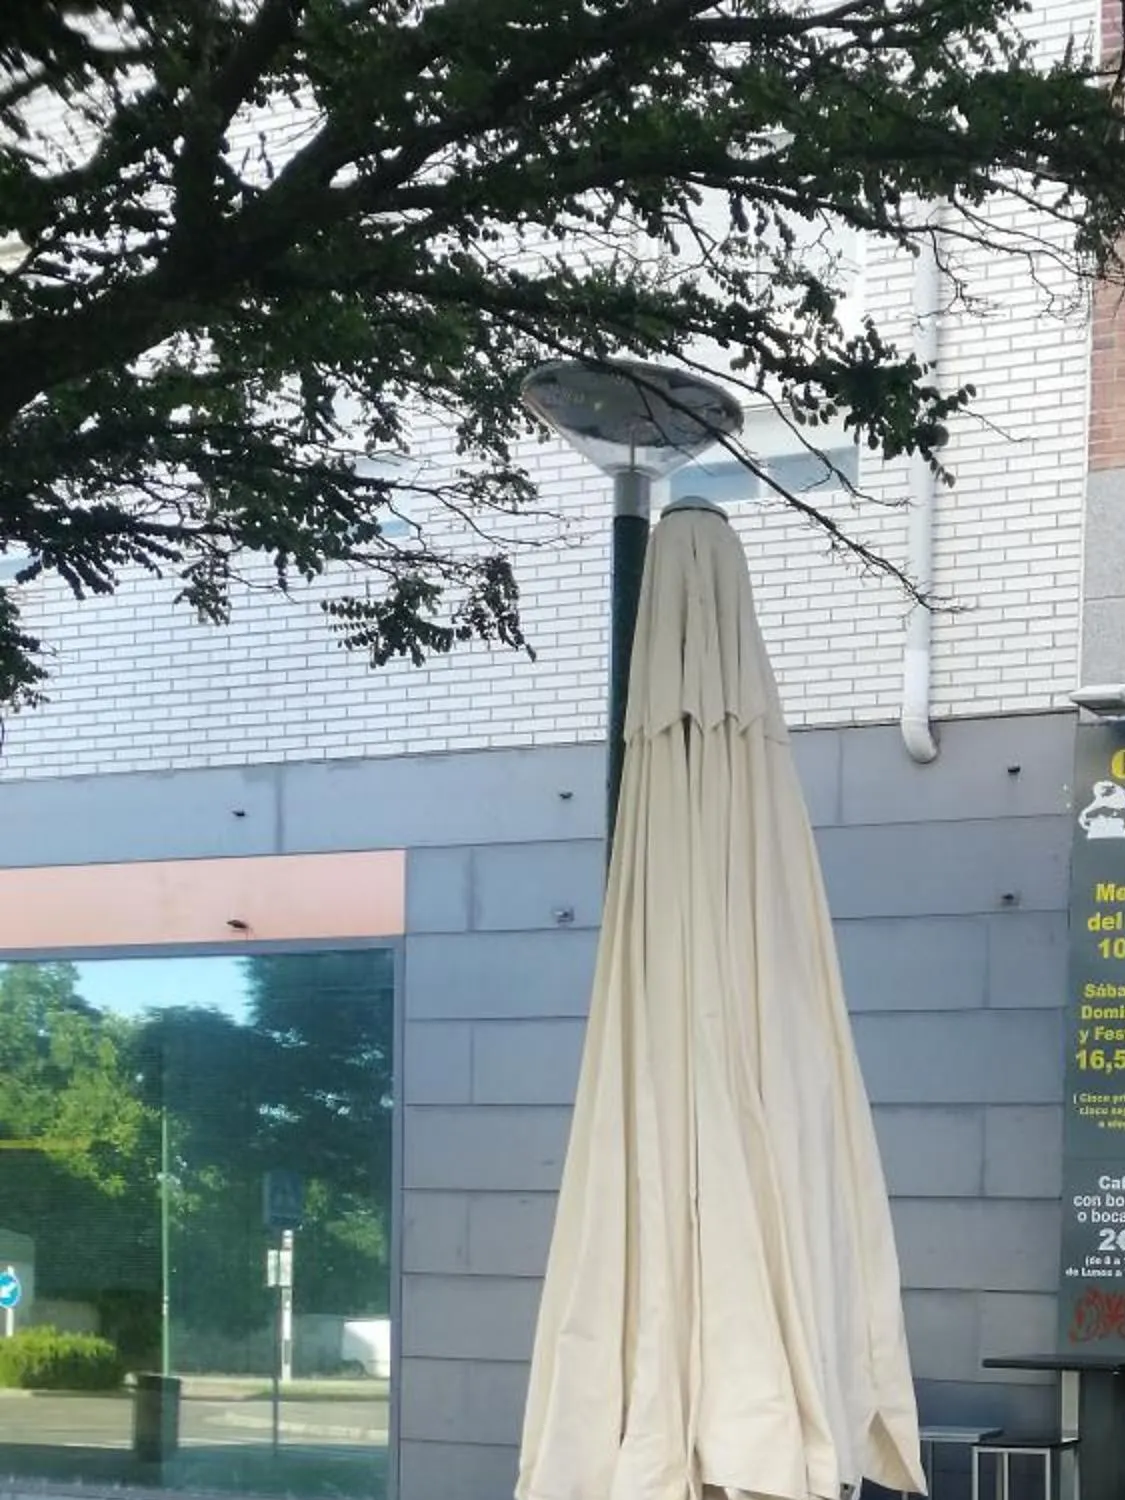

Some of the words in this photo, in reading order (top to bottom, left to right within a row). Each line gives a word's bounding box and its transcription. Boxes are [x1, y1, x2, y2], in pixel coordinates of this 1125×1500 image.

[1088, 911, 1122, 931] del
[1078, 1030, 1089, 1044] y
[1073, 1195, 1102, 1207] con
[1077, 1211, 1088, 1223] o
[1065, 1267, 1079, 1277] de
[1081, 1267, 1113, 1278] Lunes
